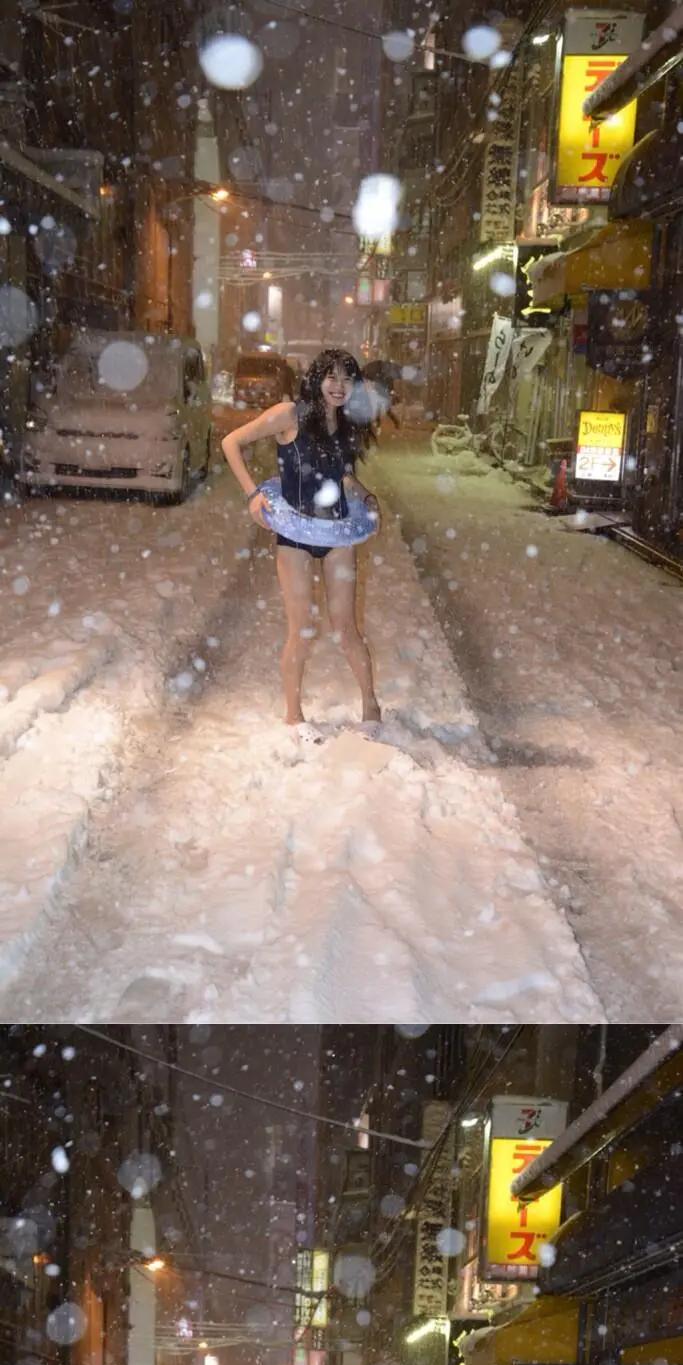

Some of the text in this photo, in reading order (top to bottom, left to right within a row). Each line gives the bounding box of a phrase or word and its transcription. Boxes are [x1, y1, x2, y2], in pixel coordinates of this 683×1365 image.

[577, 60, 623, 183] デーズ
[507, 1144, 548, 1261] デーズ
